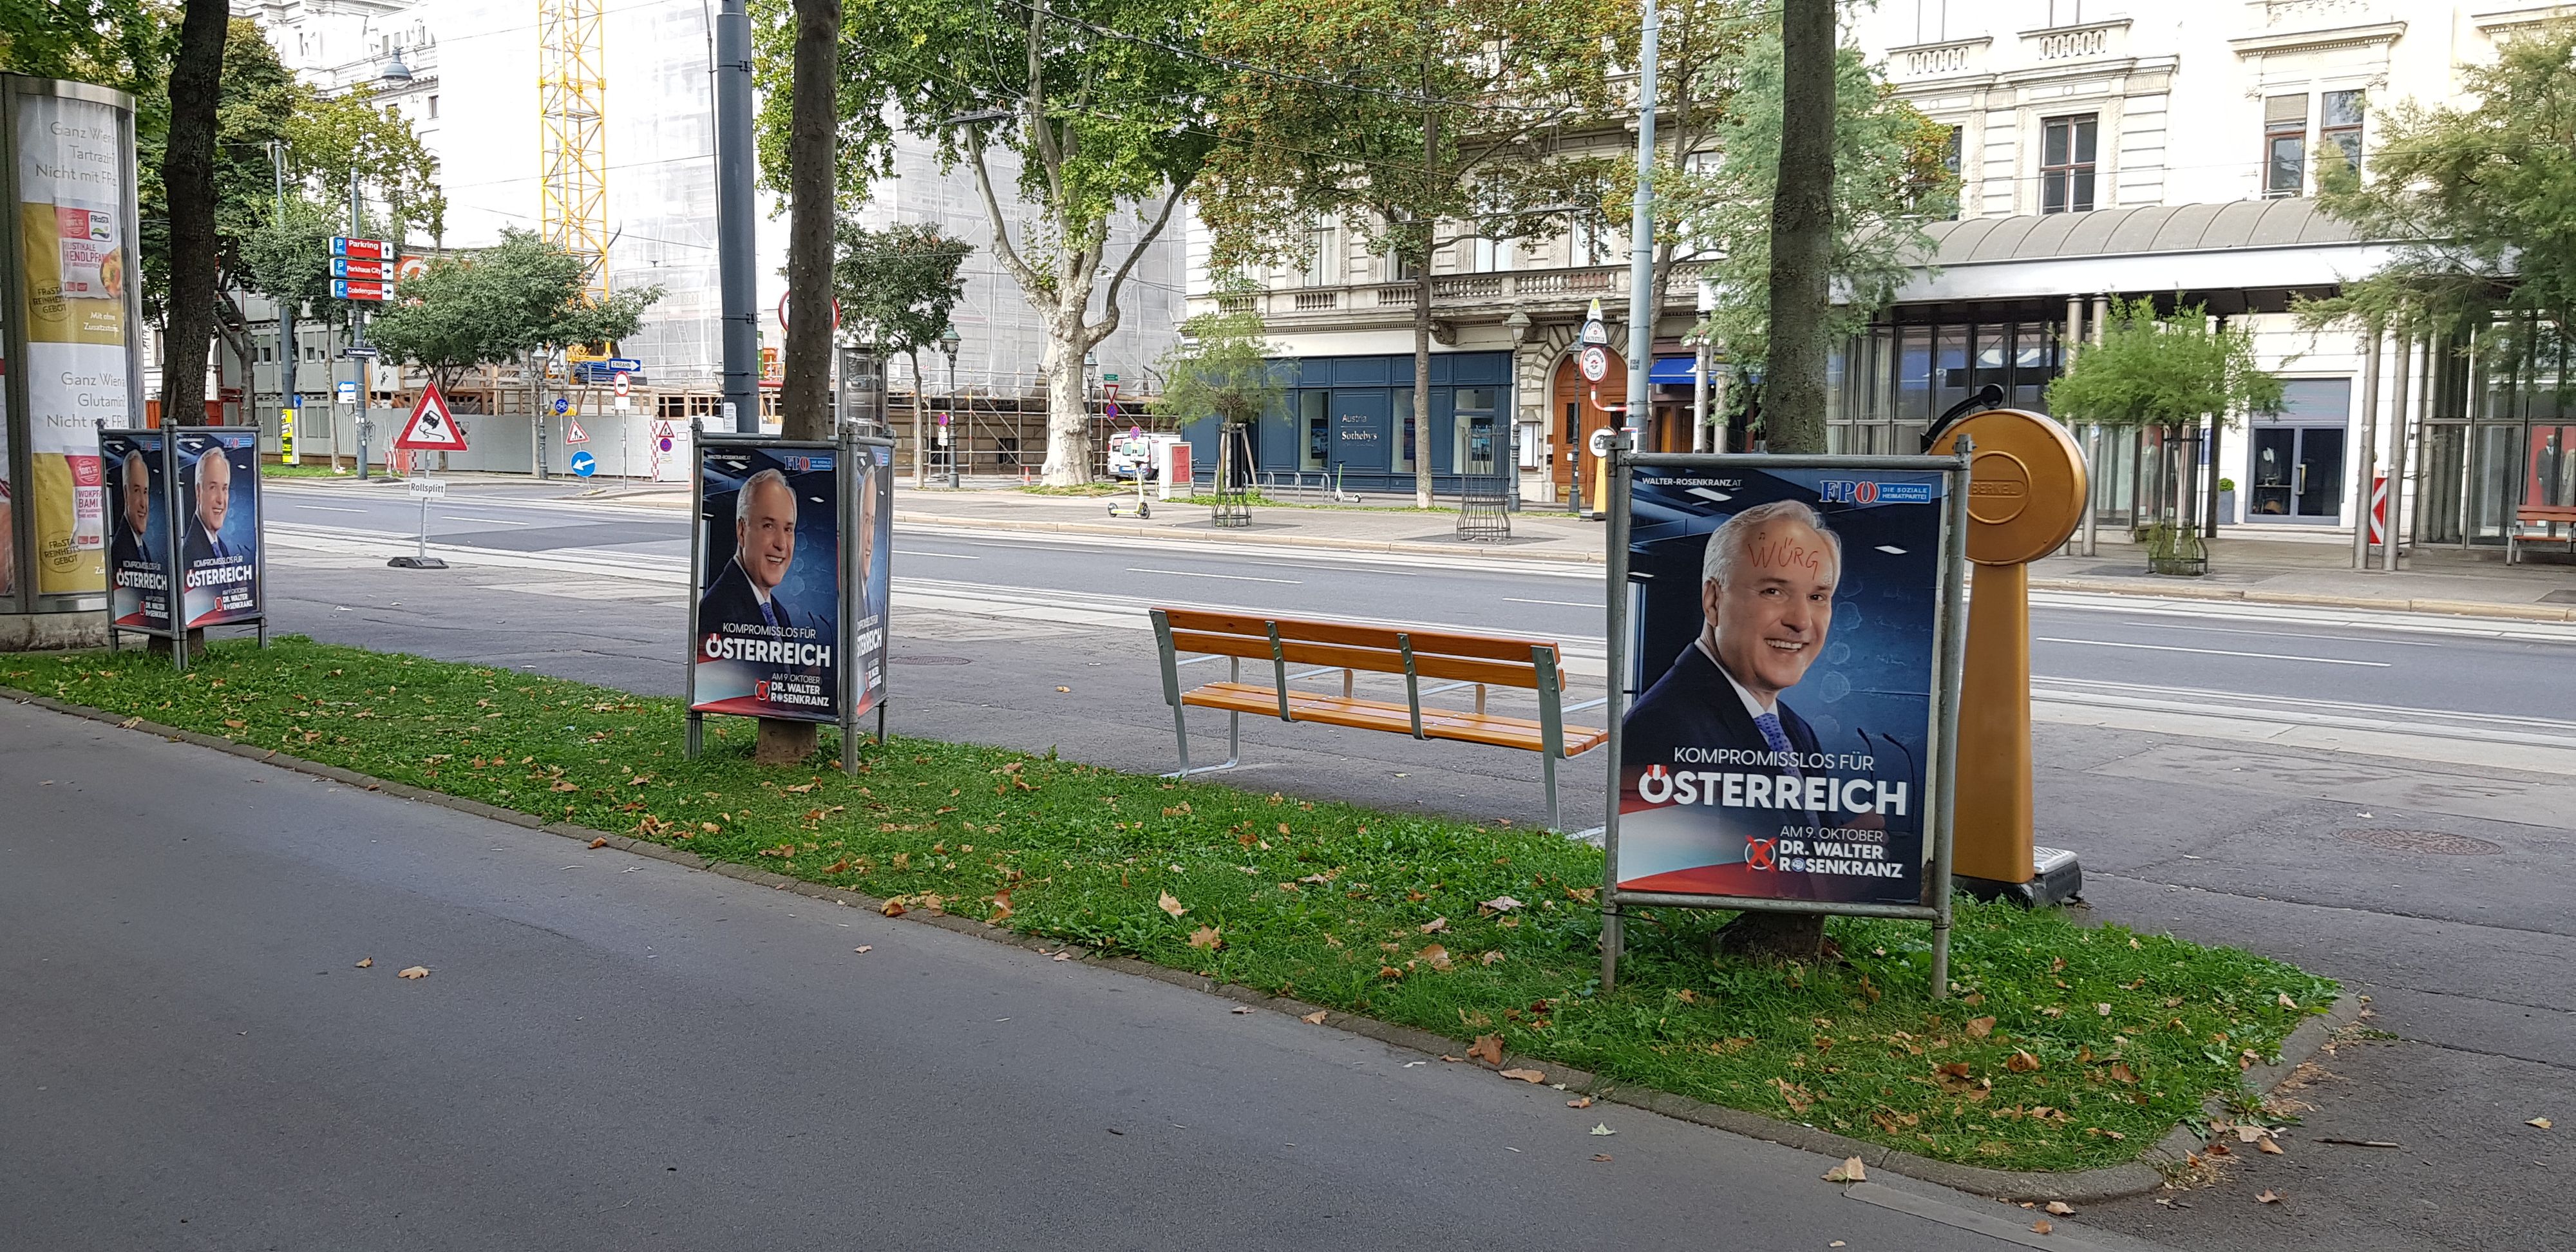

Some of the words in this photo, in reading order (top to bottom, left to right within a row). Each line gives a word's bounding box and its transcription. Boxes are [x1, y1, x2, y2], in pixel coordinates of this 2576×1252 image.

[50, 121, 86, 138] Ganz
[35, 164, 76, 180] Nicht
[80, 171, 99, 184] mit
[348, 240, 379, 250] Parkring
[346, 265, 371, 274] Parkhaus
[371, 267, 381, 276] City
[61, 372, 96, 386] Ganz
[47, 413, 87, 428] Nicht
[411, 482, 444, 494] Rollsplitt
[1642, 477, 1743, 487] WALTER-ROSENKRANZ.AT
[1972, 482, 2017, 495] BERKEL
[79, 498, 99, 508] BAMI
[54, 554, 78, 565] GEBOT
[1747, 536, 1819, 580] WÜRG
[116, 567, 168, 591] ÖSTERREICH
[186, 565, 252, 588] ÖSTERREICH
[723, 622, 798, 638] KOMPROMISSLOS
[799, 626, 816, 640] FÜR
[705, 632, 831, 668] ÖSTERREICH
[772, 672, 783, 681] AM
[790, 674, 820, 684] OKTOBER
[771, 681, 786, 692] DR.
[787, 683, 820, 695] WALTER
[1674, 746, 1835, 770] KOMPROMISSLOS
[1839, 751, 1875, 772] FÜR
[1638, 764, 1908, 816] ÖSTERREICH
[1779, 825, 1803, 838] AM
[1805, 827, 1817, 839] 9.
[1819, 828, 1884, 842] OKTOBER
[1779, 840, 1810, 856] DR.
[1813, 841, 1884, 860] WALTER
